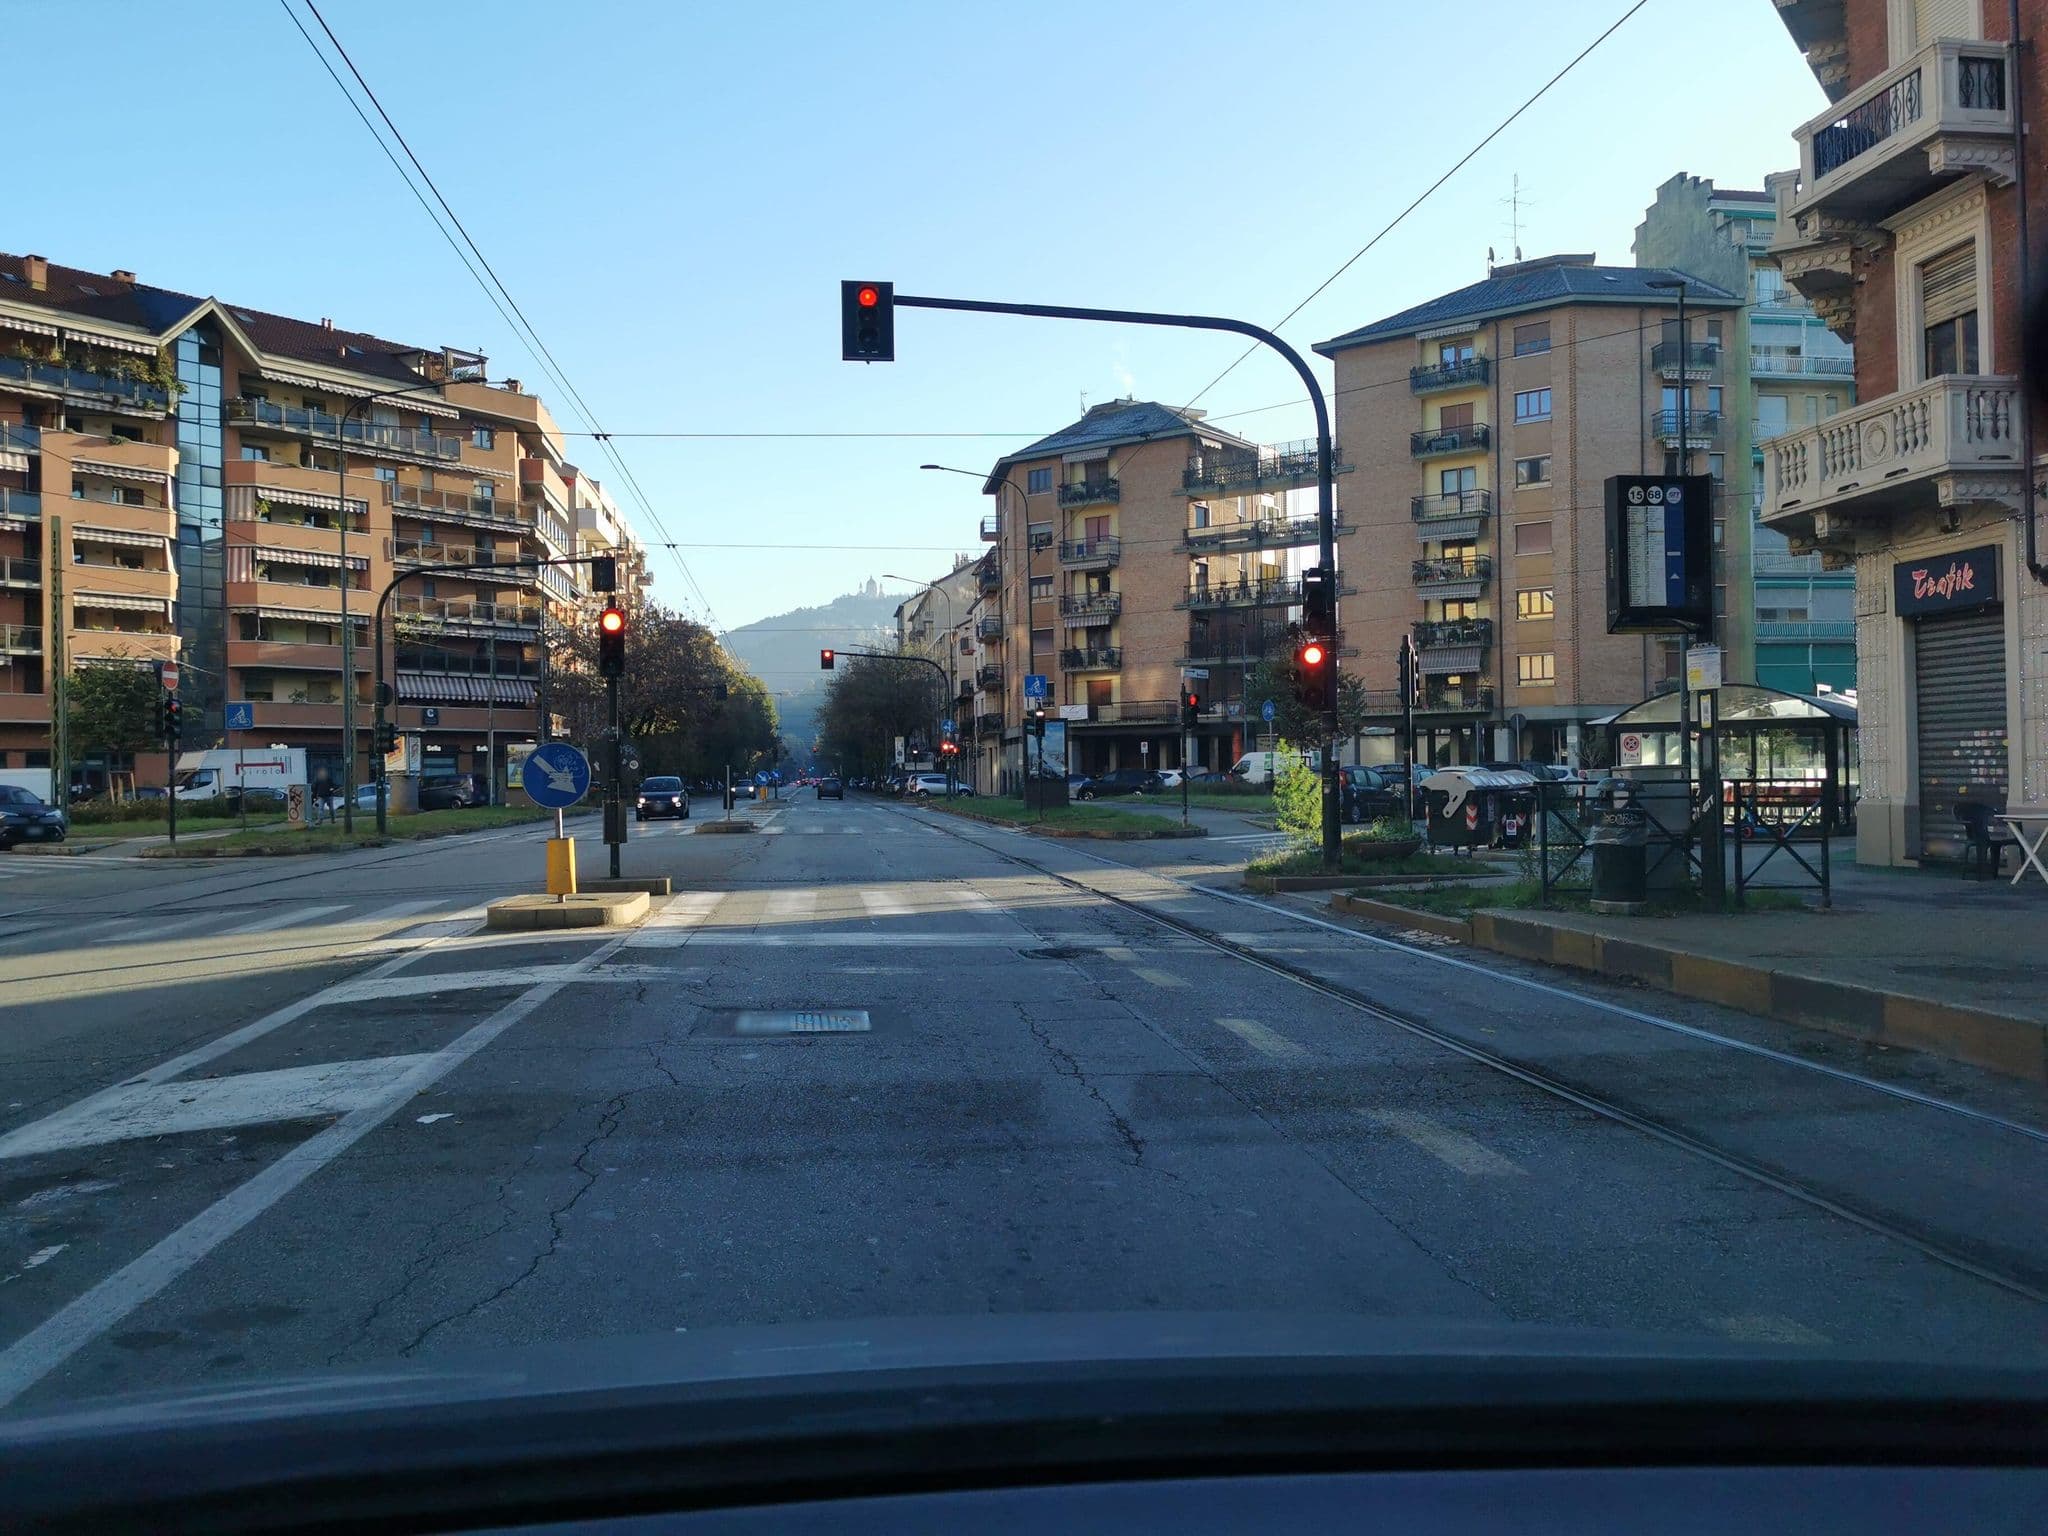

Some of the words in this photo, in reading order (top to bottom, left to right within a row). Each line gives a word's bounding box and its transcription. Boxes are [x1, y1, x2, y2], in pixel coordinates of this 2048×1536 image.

[1630, 490, 1643, 500] 15
[1648, 490, 1661, 500] 68
[1911, 562, 1974, 600] Trafik
